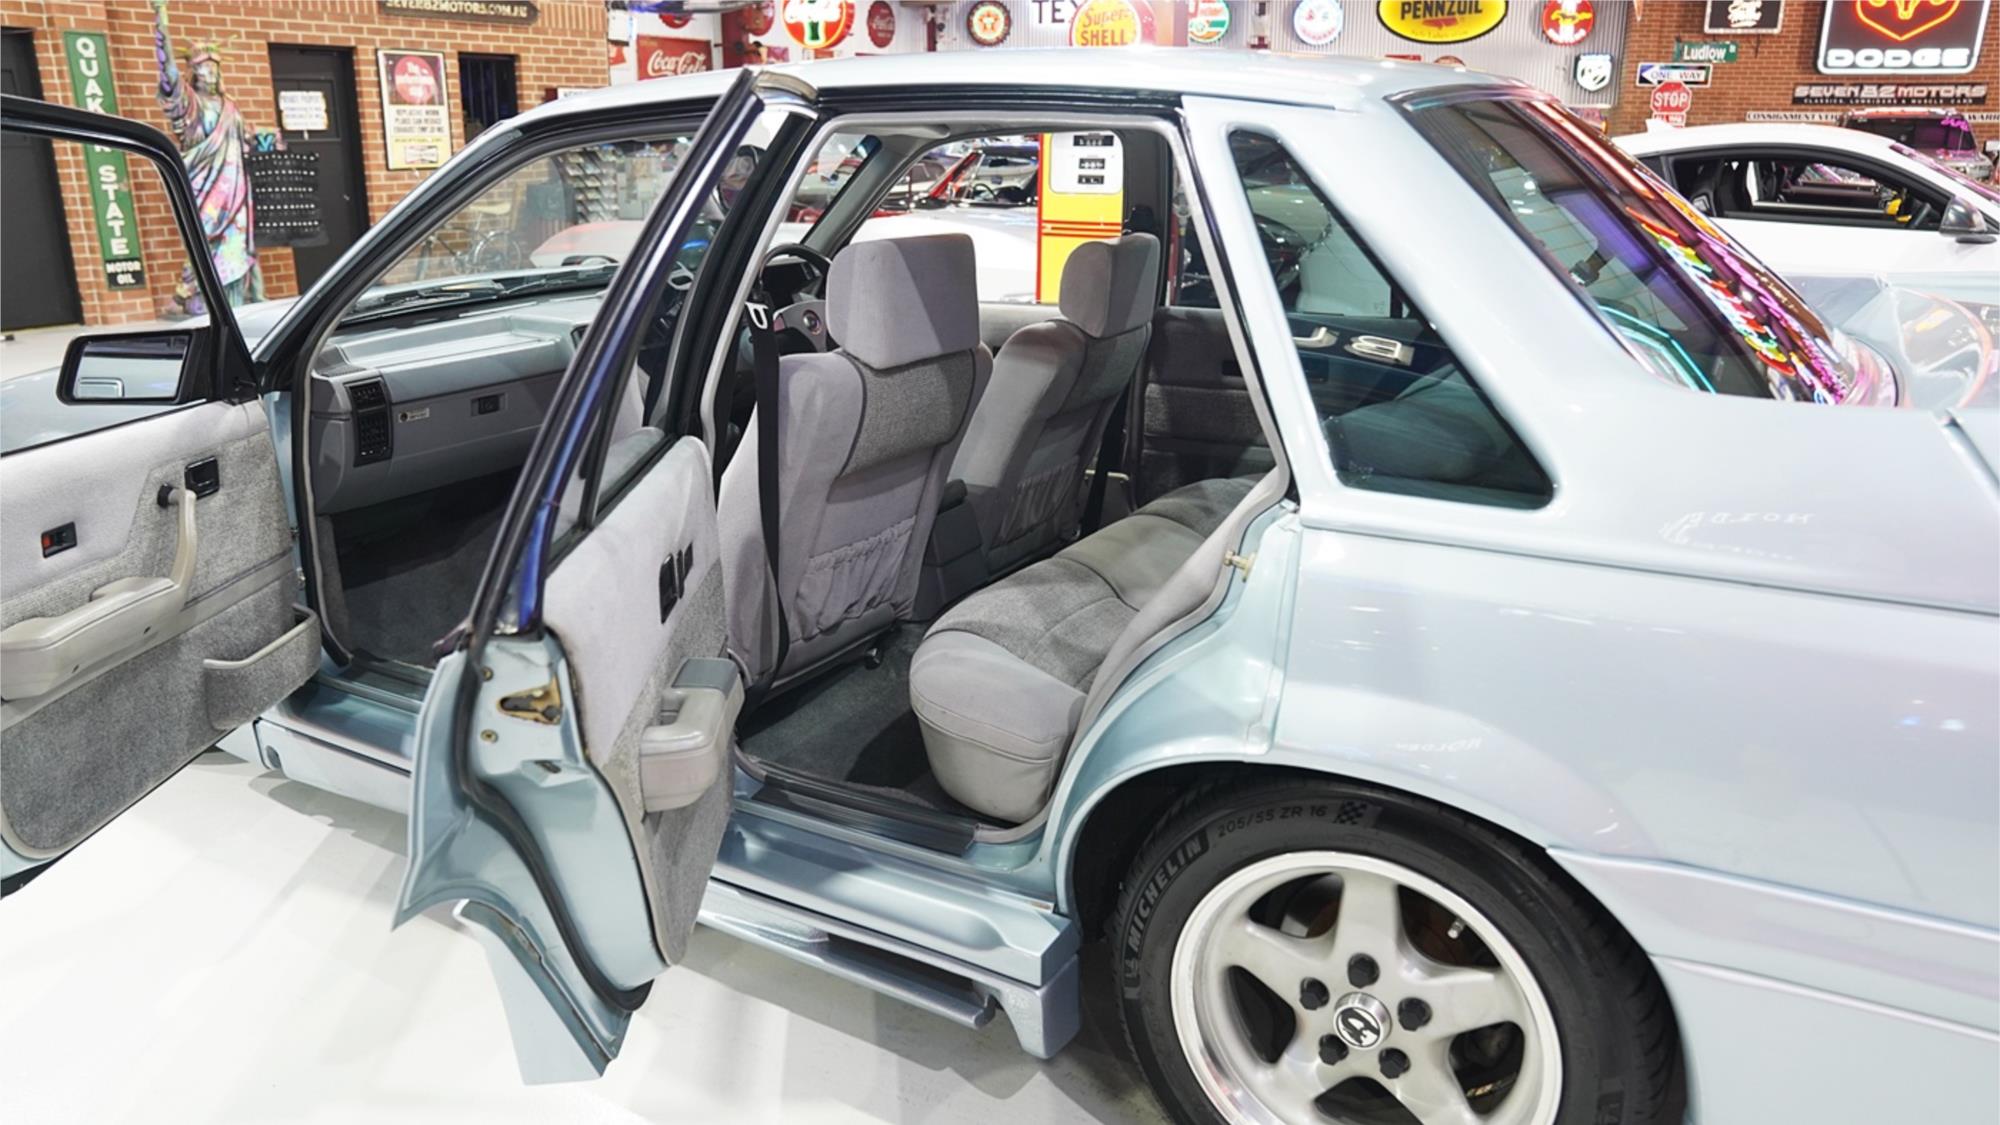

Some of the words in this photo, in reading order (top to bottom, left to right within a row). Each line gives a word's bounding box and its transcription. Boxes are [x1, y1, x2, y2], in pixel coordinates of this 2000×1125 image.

[1080, 29, 1129, 46] SHELL
[1683, 45, 1727, 61] Ludlow
[1827, 48, 1970, 67] DODGE
[1650, 71, 1671, 80] ONE
[1679, 71, 1702, 80] WAY
[1653, 91, 1689, 108] STOP
[98, 165, 130, 256] STATE
[106, 260, 141, 273] MOTOR
[116, 273, 136, 285] OIL
[1217, 808, 1275, 838] 205/55
[1279, 806, 1304, 819] ZR
[1309, 805, 1328, 817] 16
[1127, 838, 1201, 951] MICHELIN
